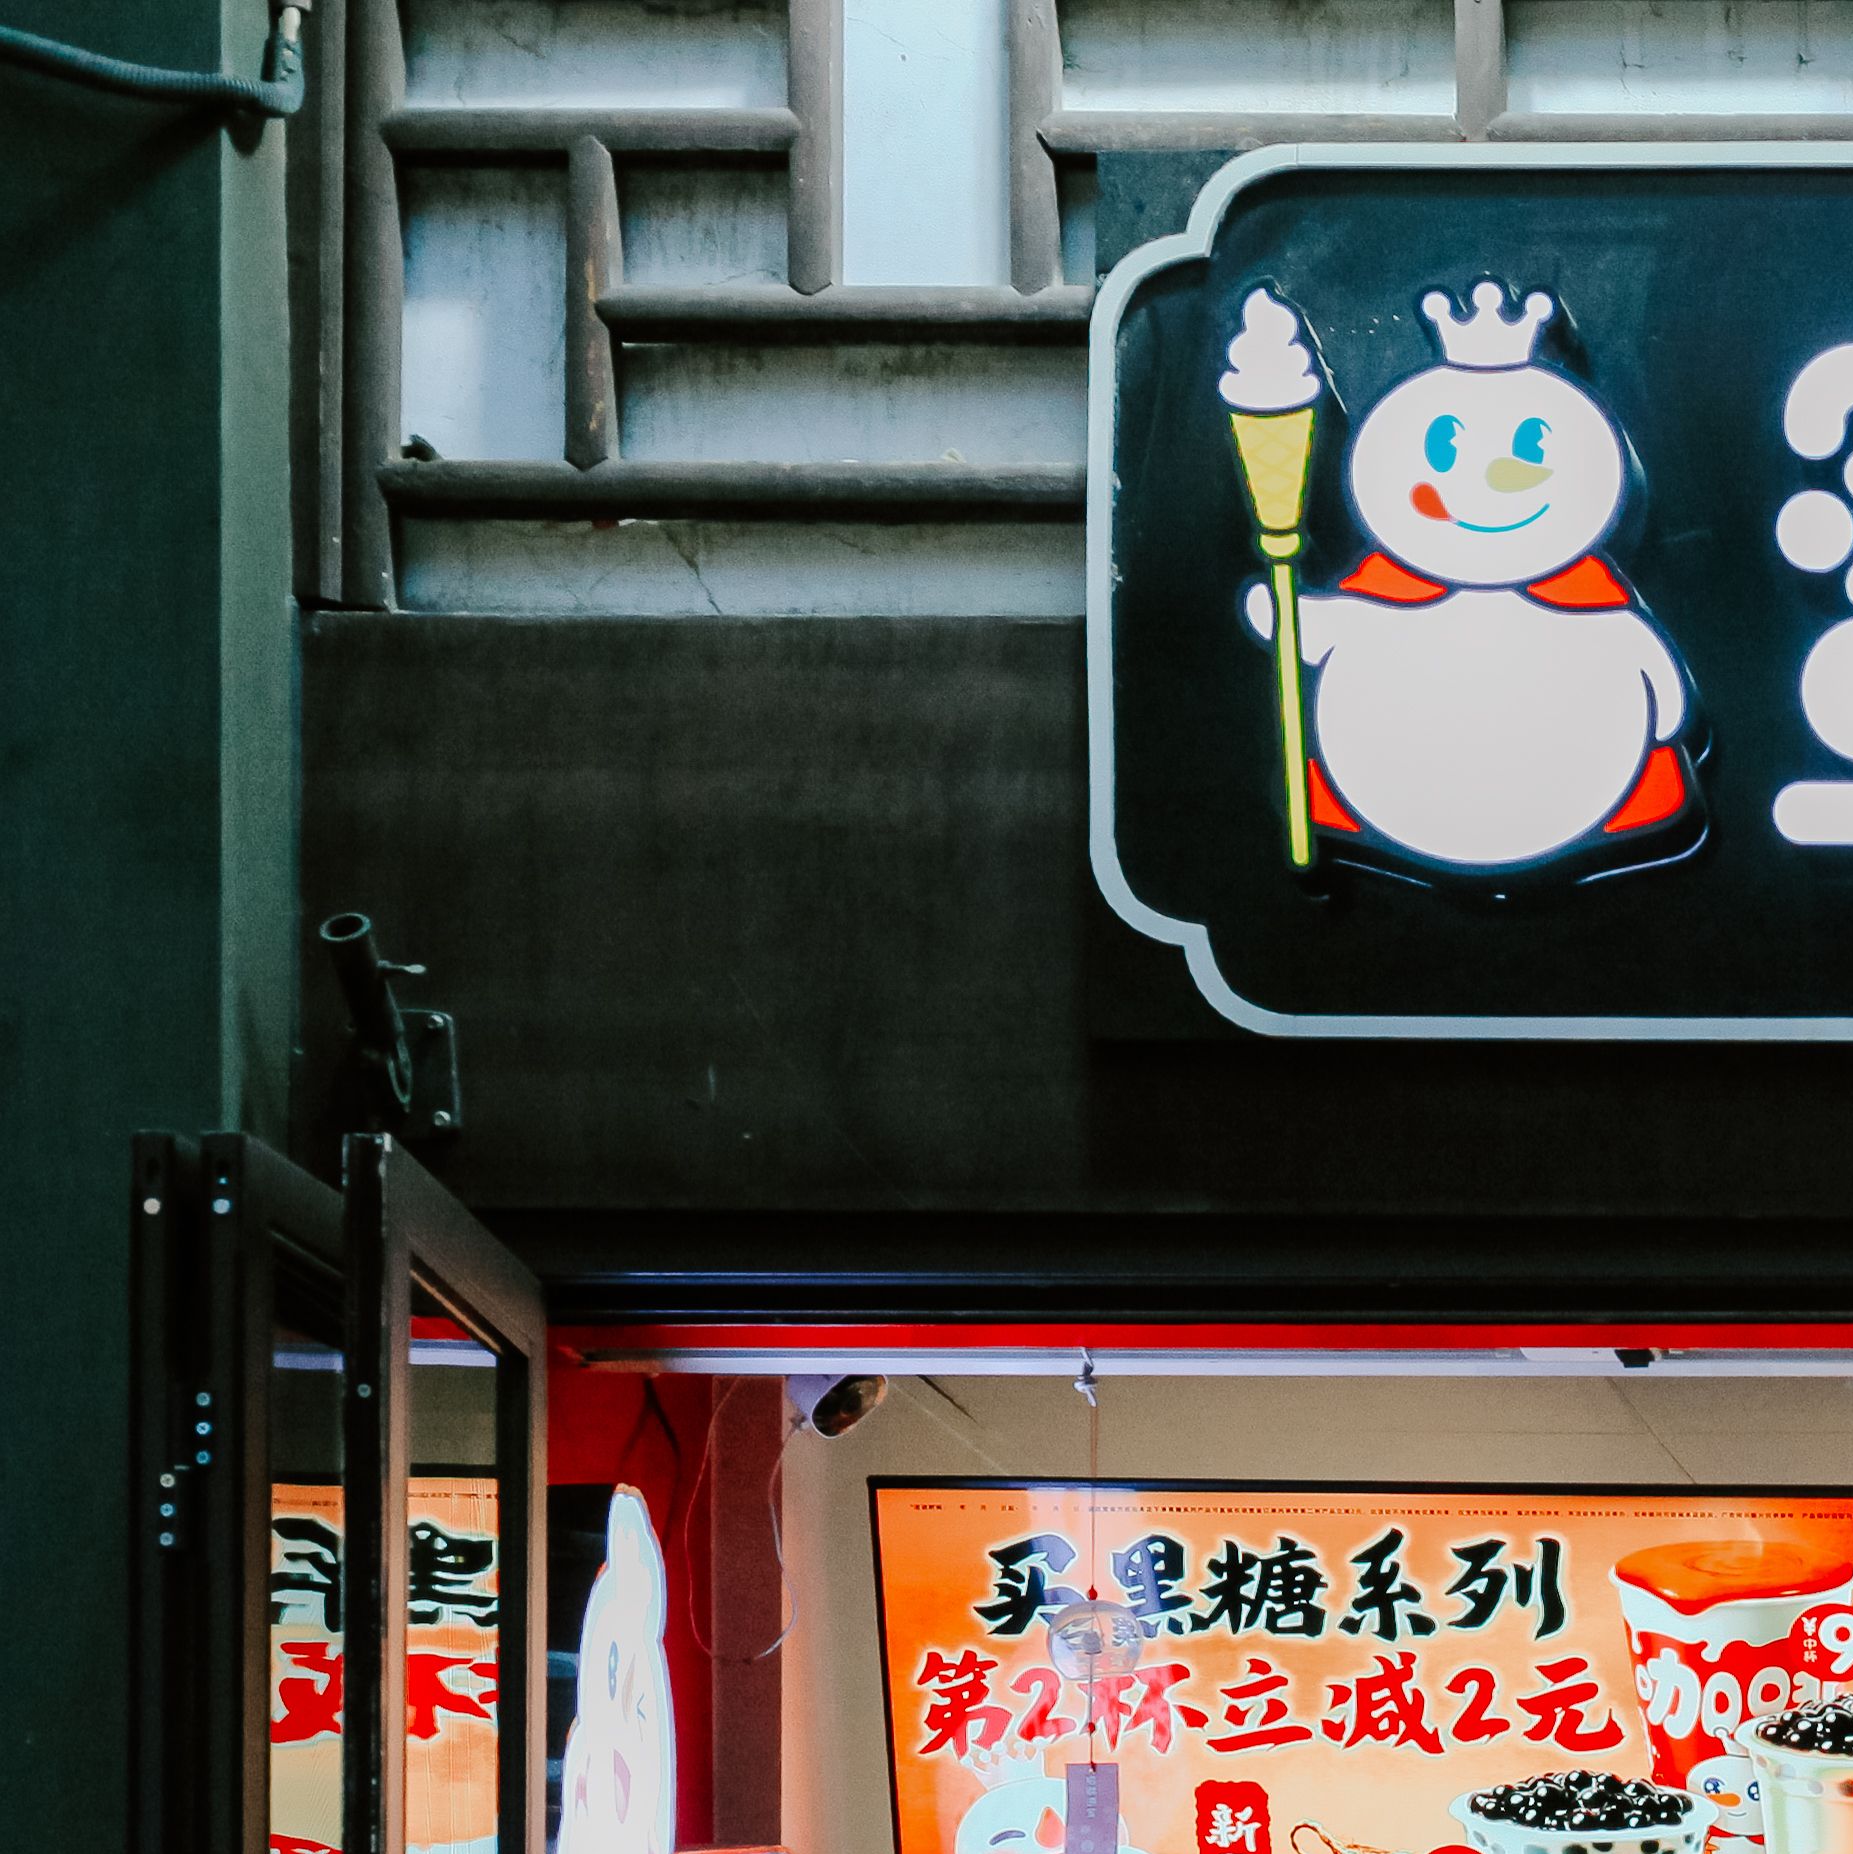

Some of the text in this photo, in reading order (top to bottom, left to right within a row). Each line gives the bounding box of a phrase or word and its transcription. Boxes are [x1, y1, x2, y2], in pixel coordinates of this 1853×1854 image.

[976, 1532, 1570, 1641] 买黑糖系列
[920, 1650, 1627, 1754] 第2杯立减2元
